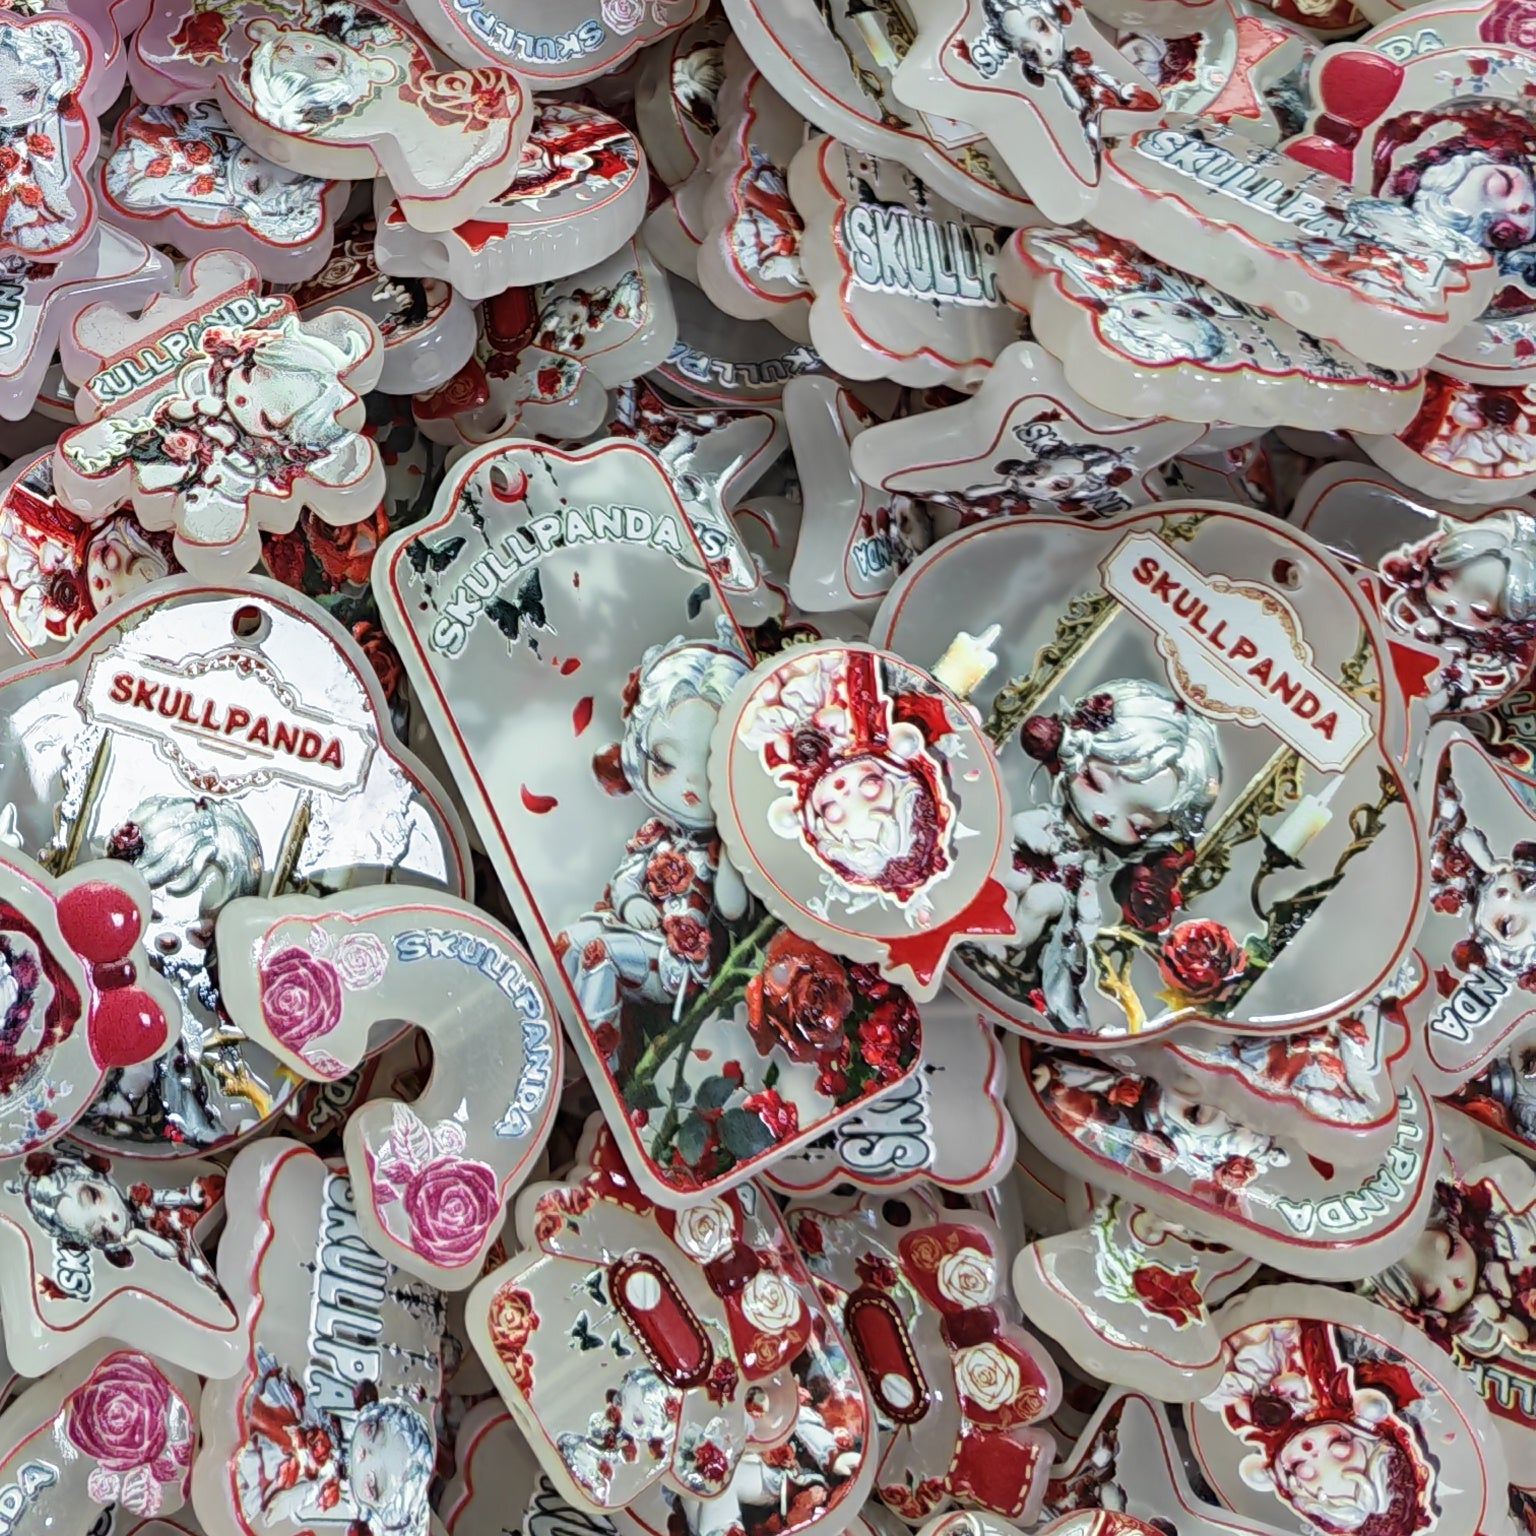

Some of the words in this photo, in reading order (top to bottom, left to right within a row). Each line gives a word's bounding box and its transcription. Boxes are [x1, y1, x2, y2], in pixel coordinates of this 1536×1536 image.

[430, 503, 684, 658] SKULLPANDA
[1132, 557, 1339, 741] SKULLPANDA
[109, 672, 344, 769] SKULLPANDA
[392, 927, 551, 1138] SKULLPANDA
